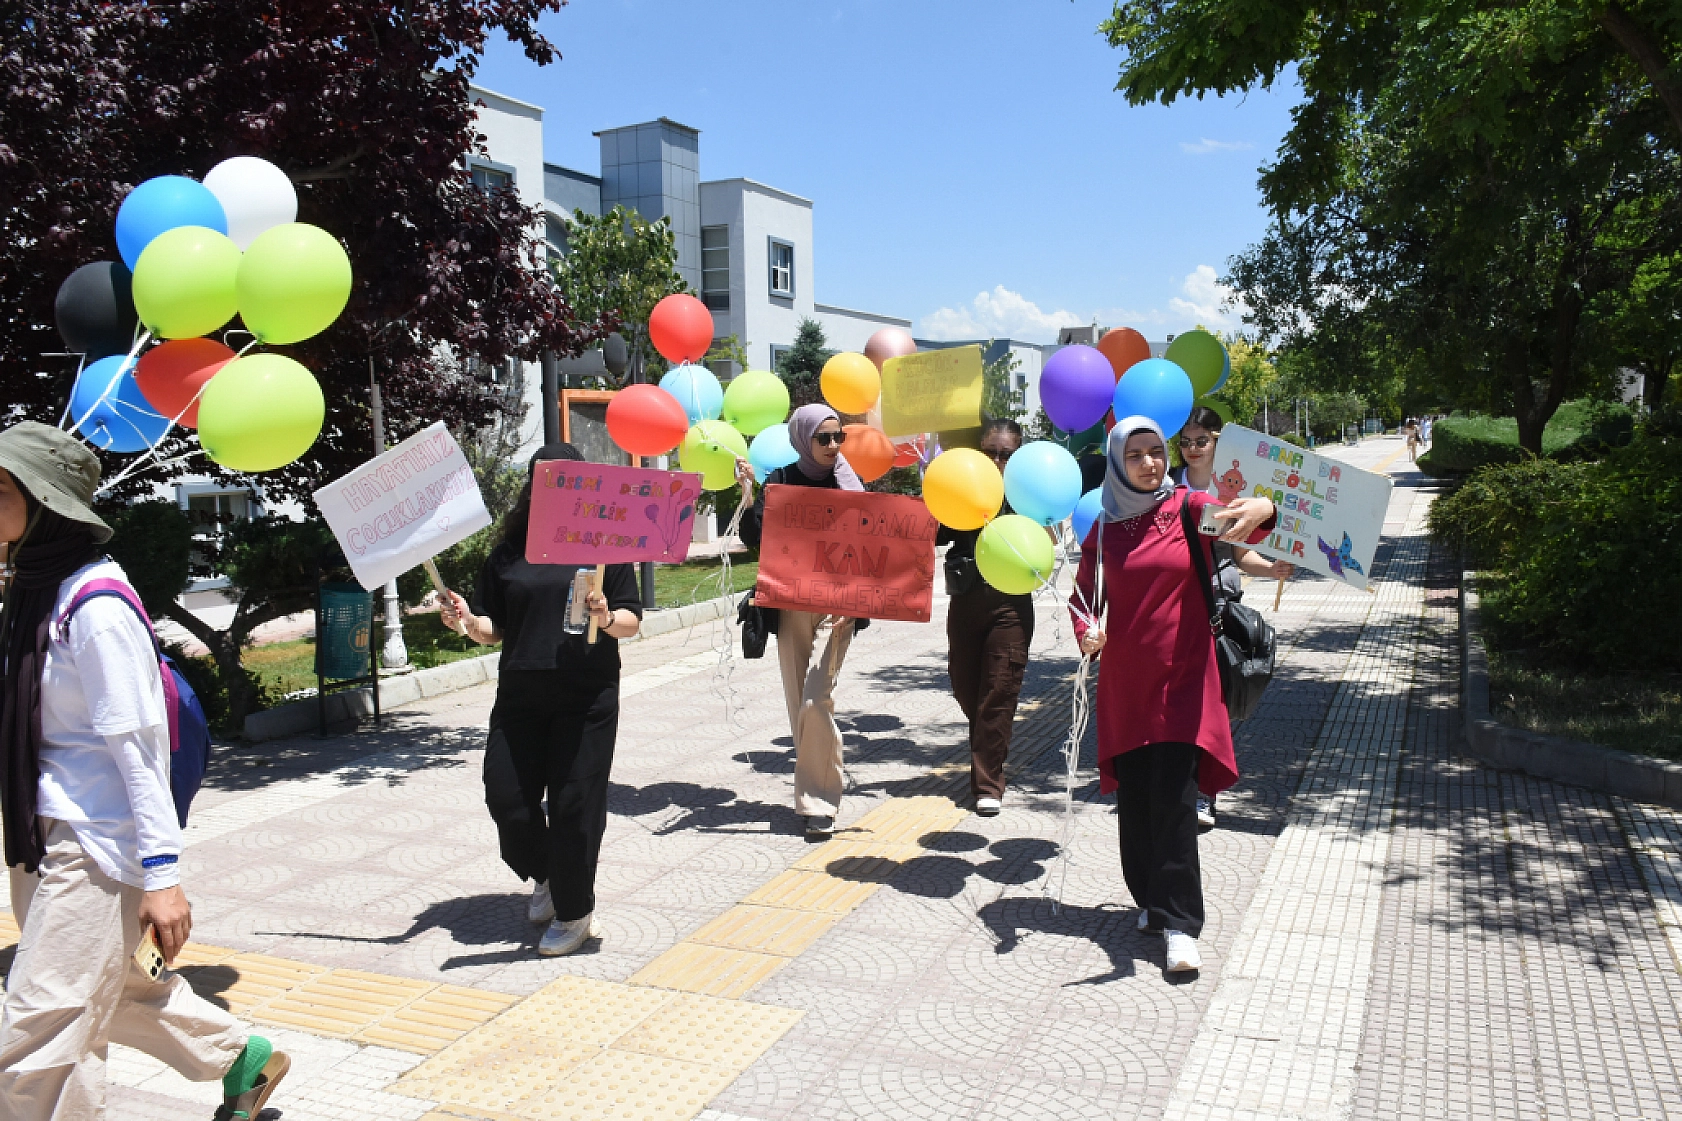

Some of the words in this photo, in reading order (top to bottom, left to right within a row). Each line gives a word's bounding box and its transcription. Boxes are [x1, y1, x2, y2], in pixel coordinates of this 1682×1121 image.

[1256, 440, 1304, 469] BANA
[1317, 461, 1342, 483] DA
[1253, 484, 1324, 520] MASKE
[1271, 469, 1338, 505] SÖYLE
[573, 497, 627, 522] İYİLİK
[784, 503, 836, 531] HER
[857, 509, 938, 541] DAMLA
[812, 540, 889, 578] KAN
